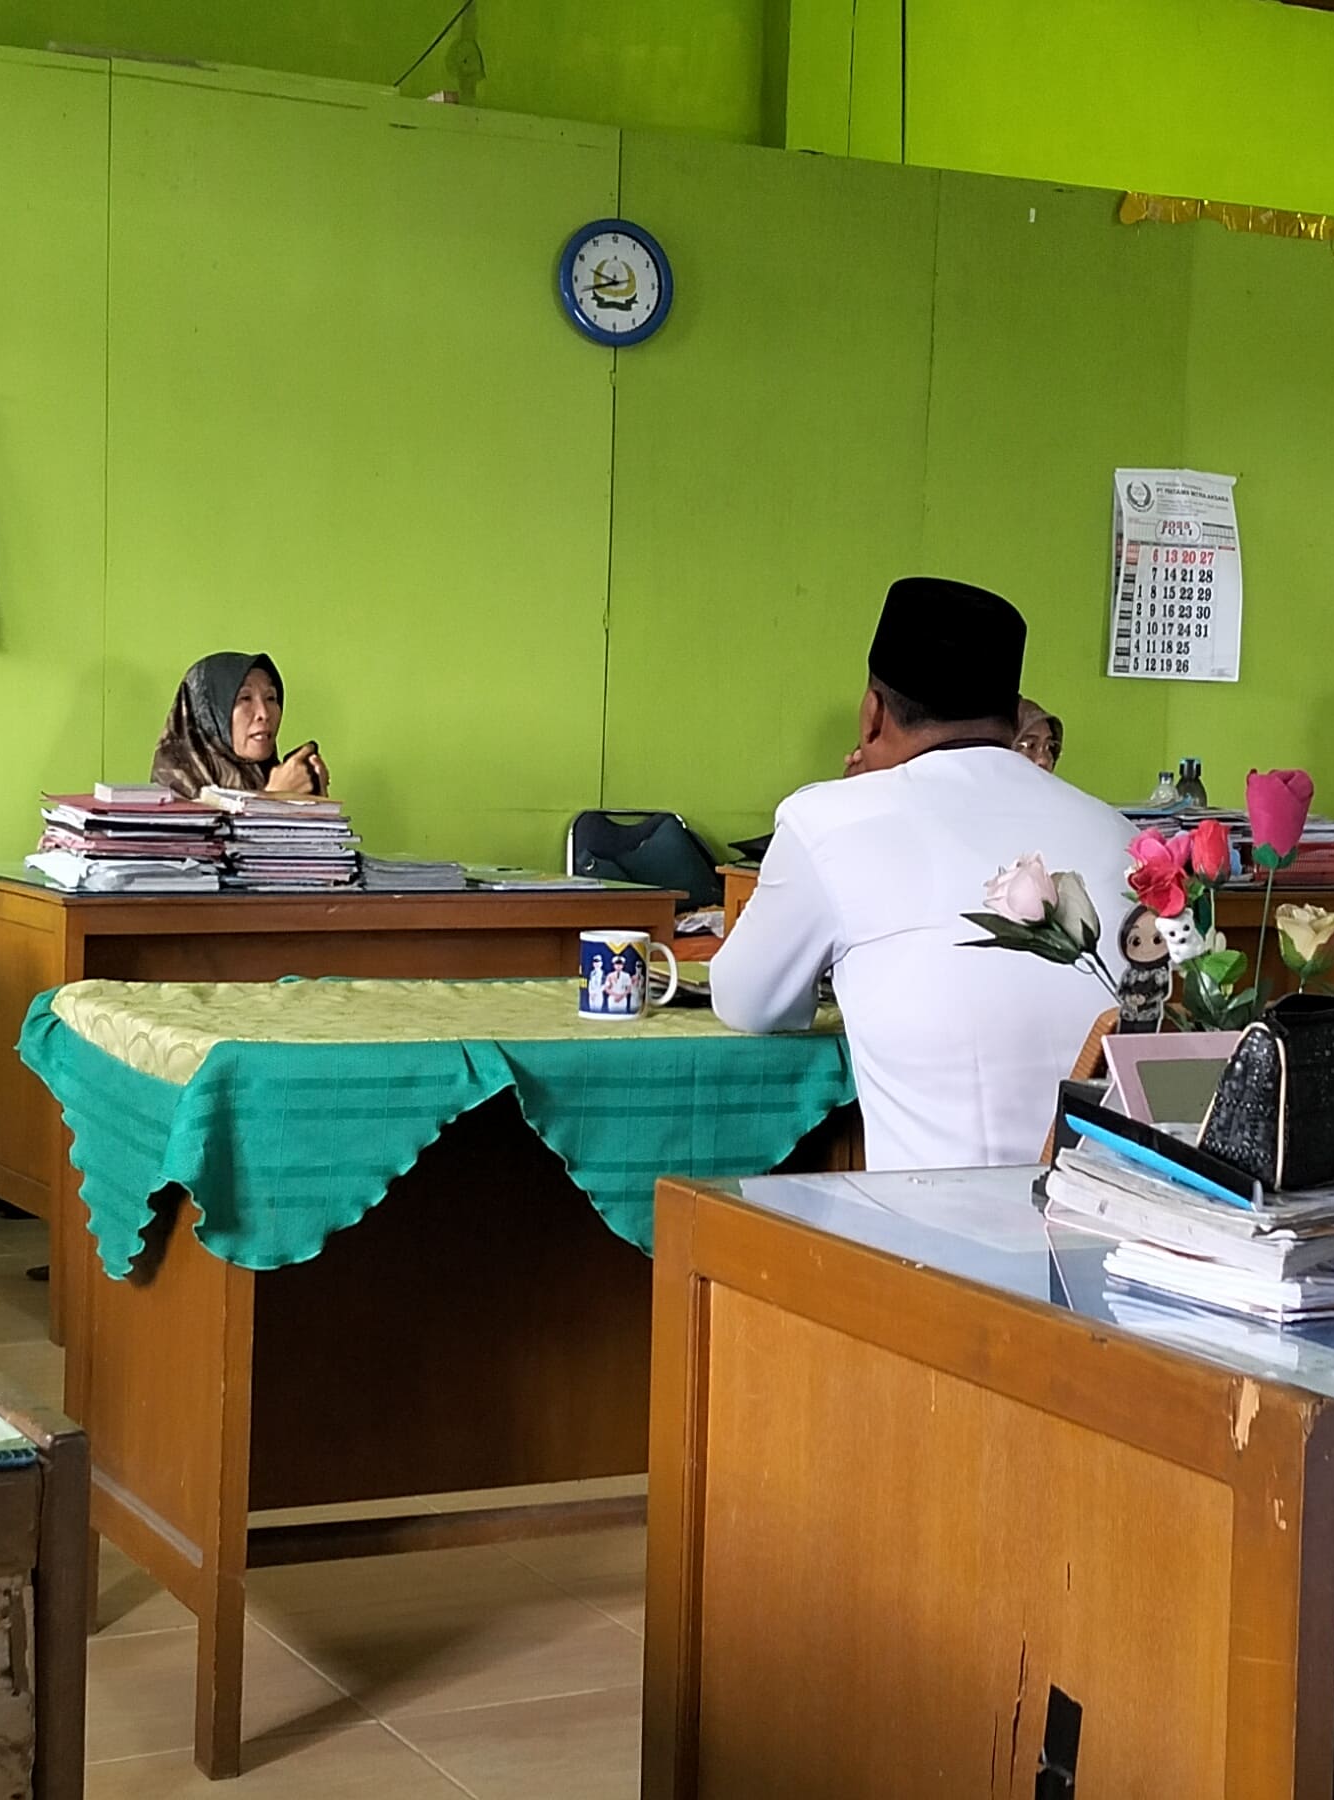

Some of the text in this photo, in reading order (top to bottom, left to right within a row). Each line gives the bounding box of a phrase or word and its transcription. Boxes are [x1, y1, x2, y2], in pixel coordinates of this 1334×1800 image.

[1153, 549, 1214, 565] 6 13 20 27
[1152, 568, 1213, 583] 7 14 21 28
[1138, 585, 1212, 602] 1 8 15 22 29
[1136, 603, 1211, 620] 2 9 16 23 30
[1135, 621, 1208, 637] 3 10 17 24 31
[1135, 640, 1190, 655] 4 11 18 25
[1133, 658, 1189, 673] 5 12 19 26
